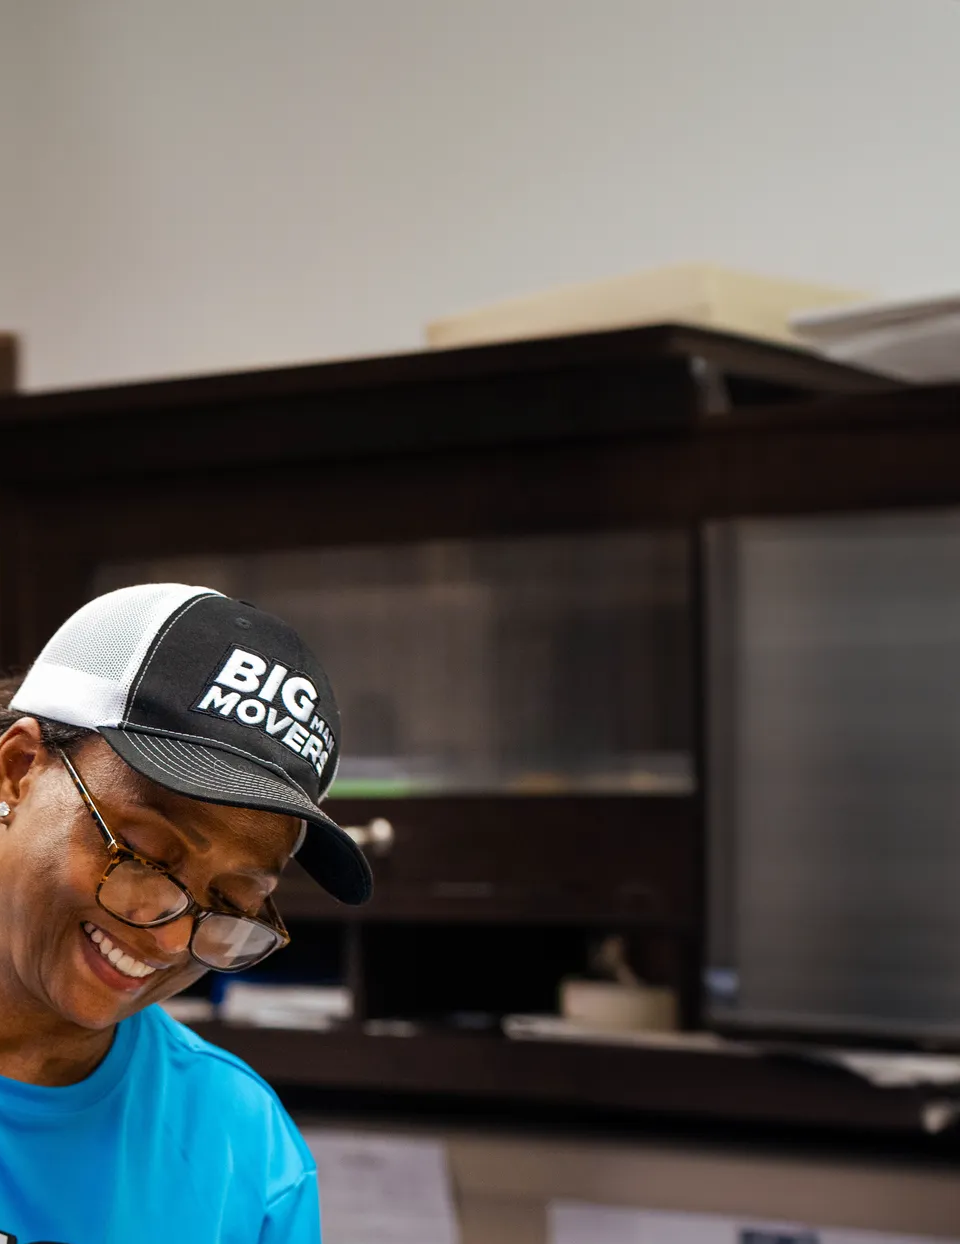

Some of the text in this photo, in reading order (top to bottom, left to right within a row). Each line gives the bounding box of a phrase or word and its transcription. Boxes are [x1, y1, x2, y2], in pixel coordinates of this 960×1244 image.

[197, 685, 329, 777] MOVERS
[214, 648, 335, 751] BIG MAN
